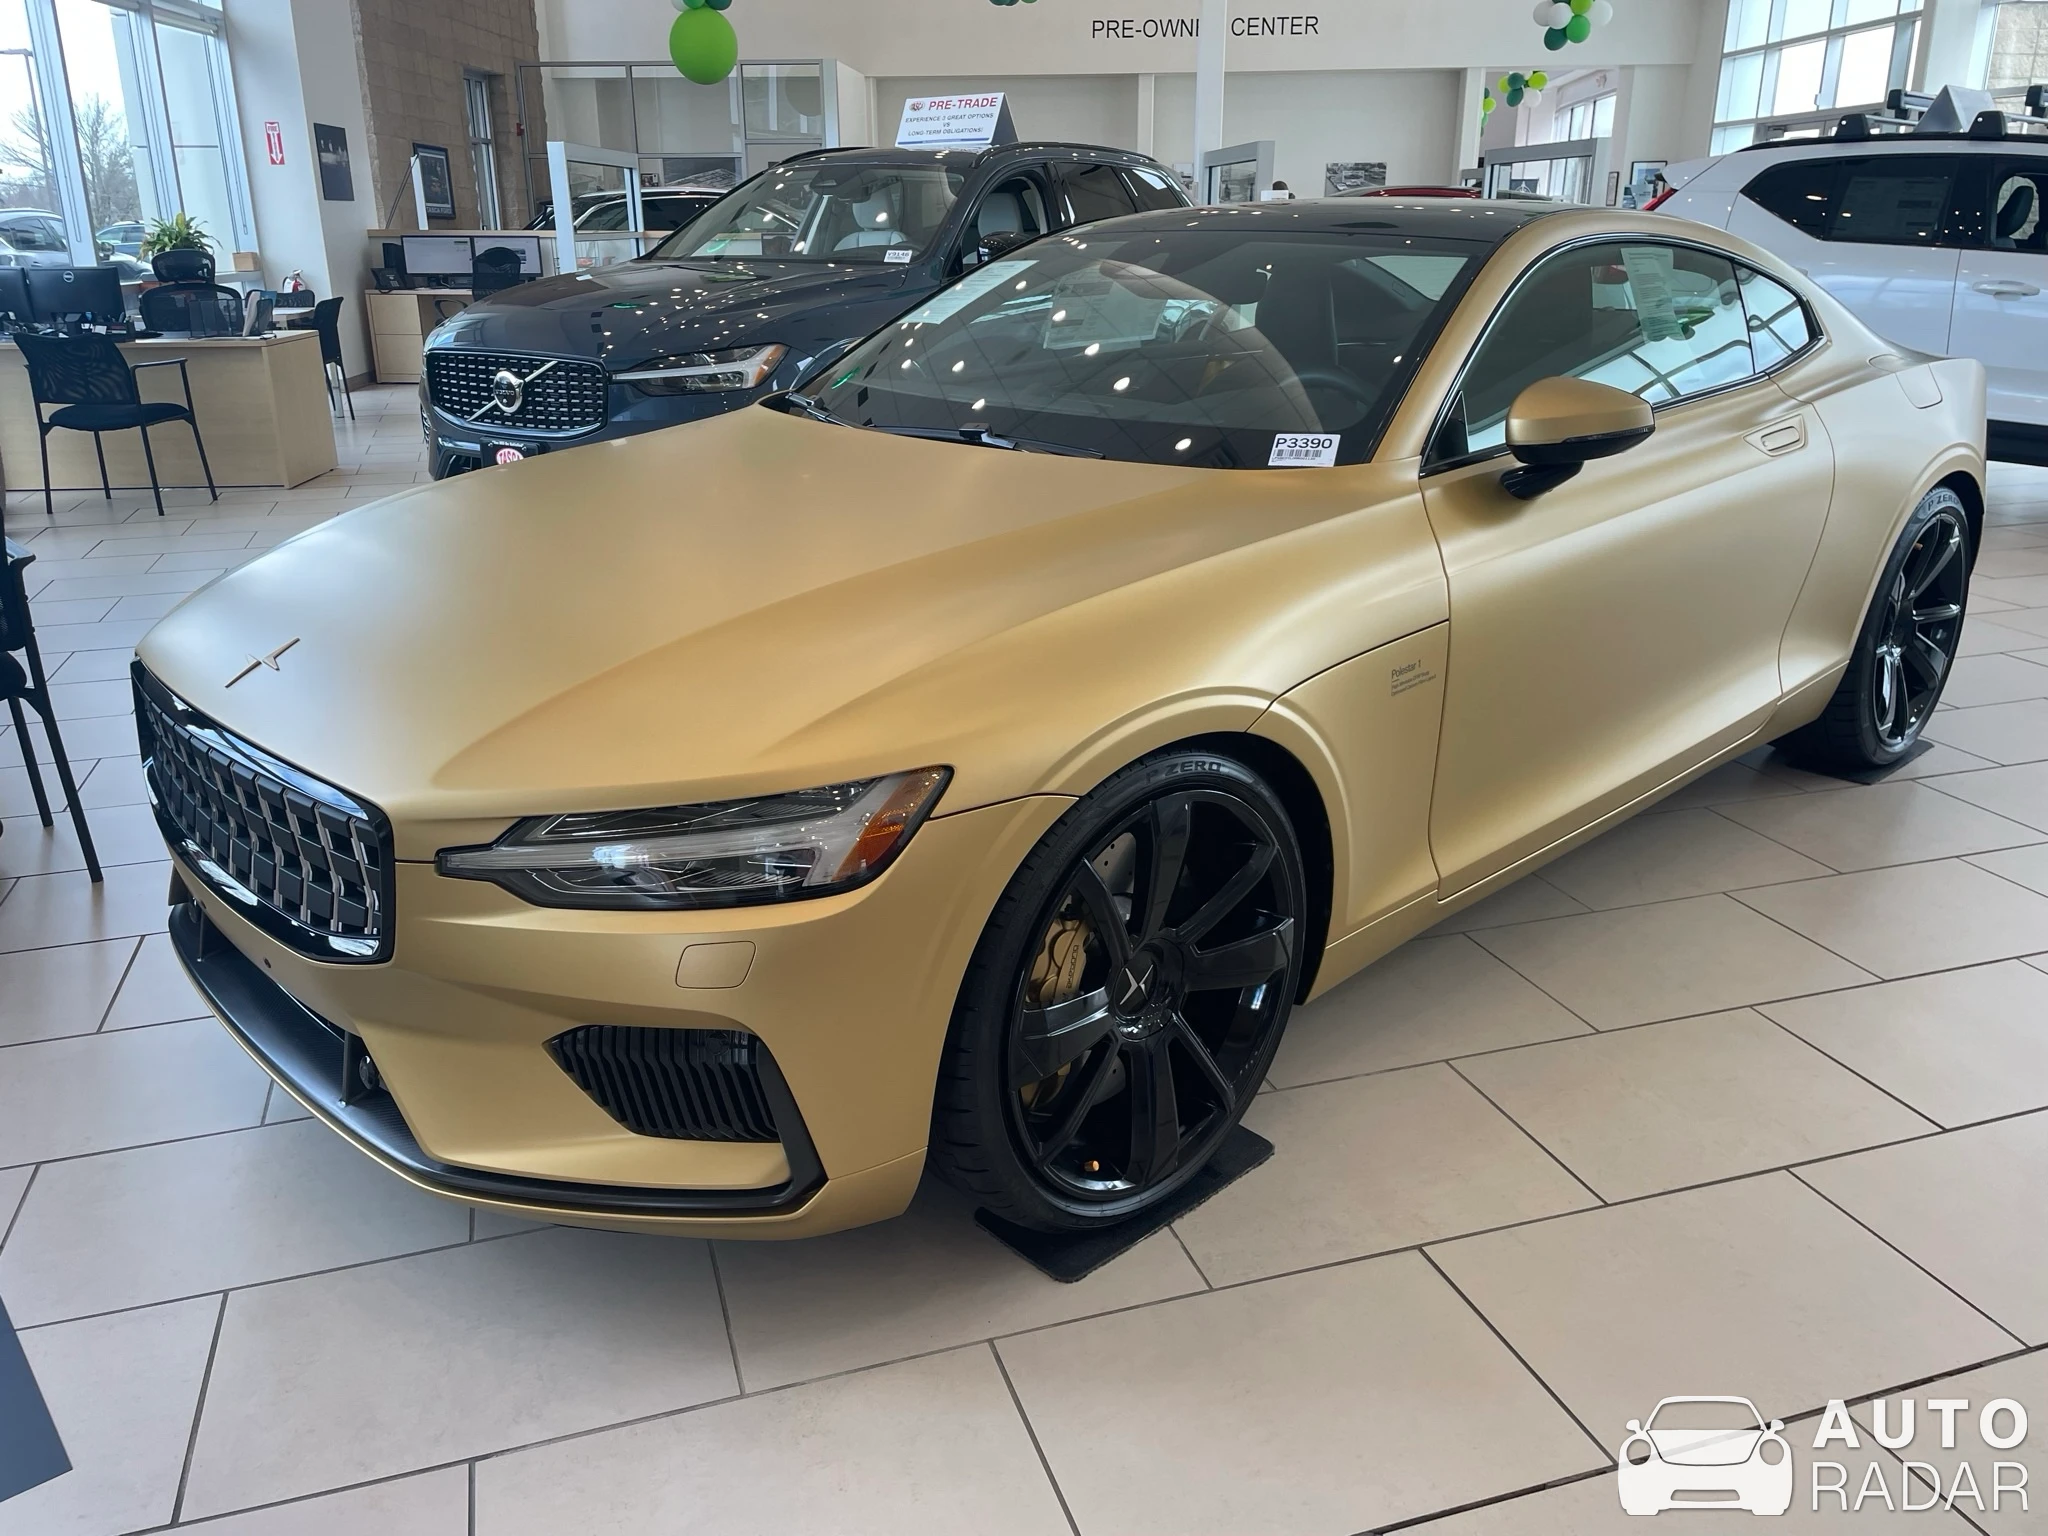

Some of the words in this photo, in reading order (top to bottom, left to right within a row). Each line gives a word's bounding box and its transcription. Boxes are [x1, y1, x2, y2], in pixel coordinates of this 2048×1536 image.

[1091, 18, 1200, 39] PRE-OWN
[1230, 15, 1320, 37] CENTER
[928, 96, 998, 111] PRE-TRADE
[1275, 437, 1333, 449] P3390
[1164, 760, 1223, 777] ZERO
